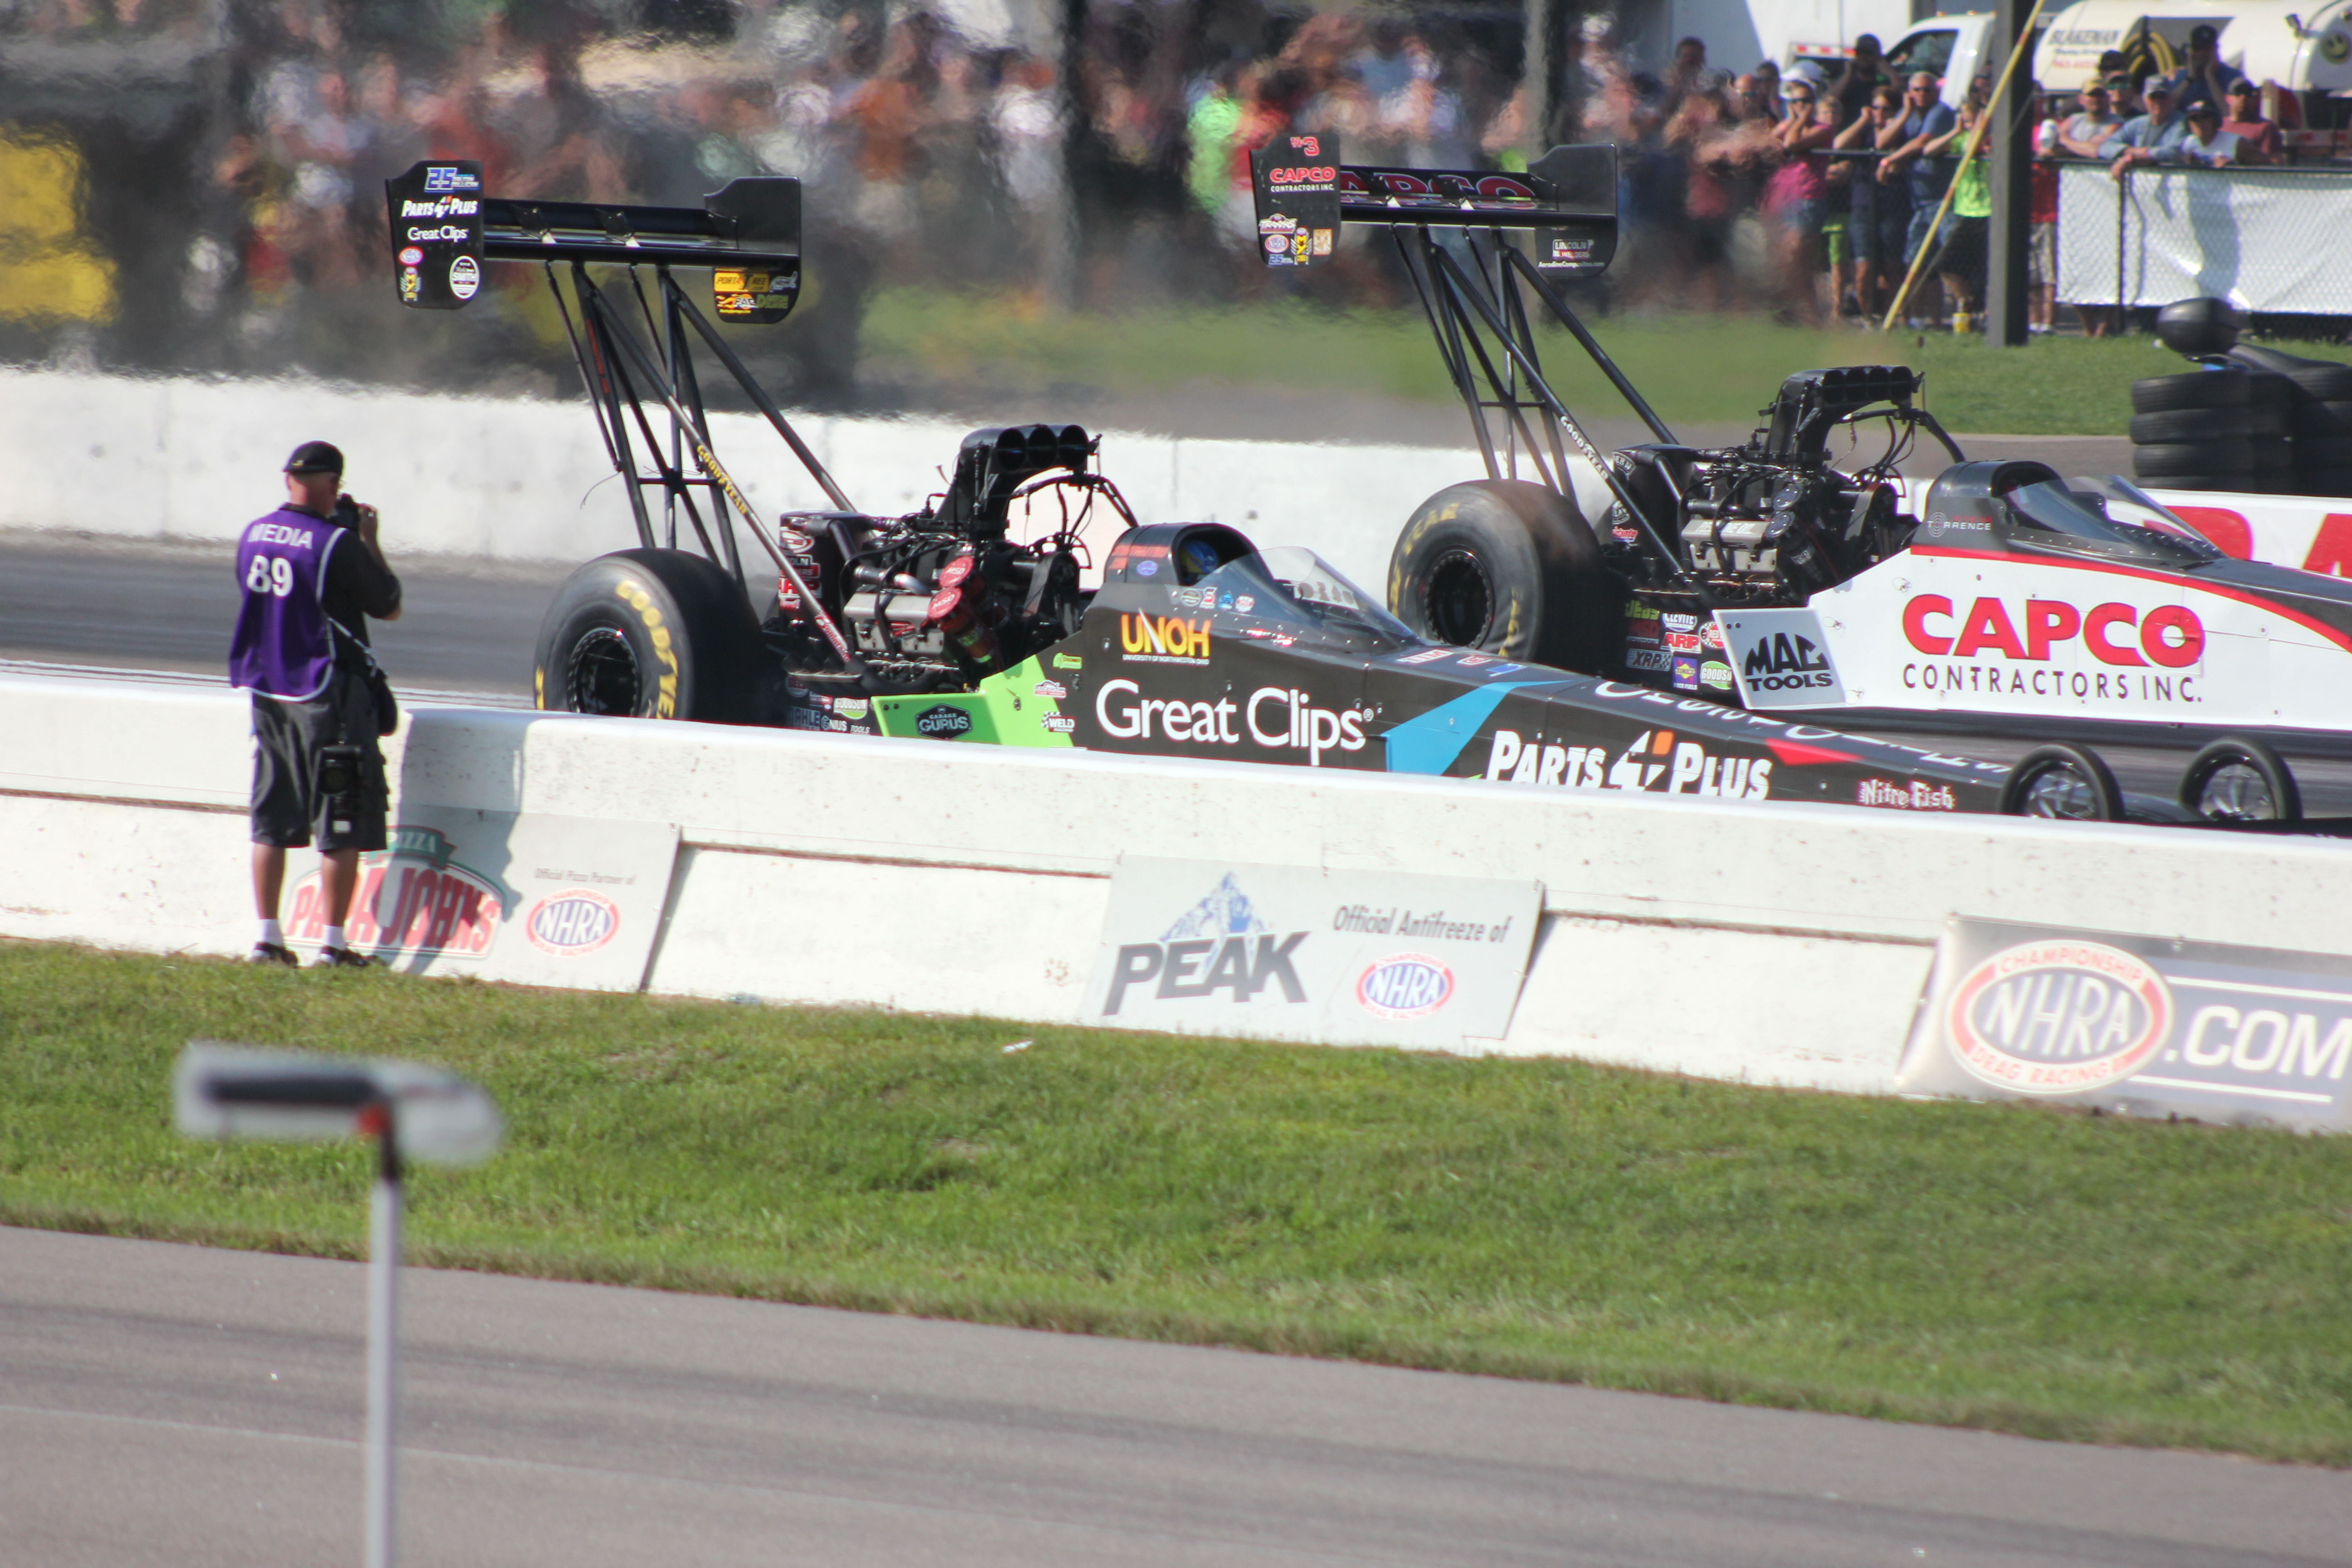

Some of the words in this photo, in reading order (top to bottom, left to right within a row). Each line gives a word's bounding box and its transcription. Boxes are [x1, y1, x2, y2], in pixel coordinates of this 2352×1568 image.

[1303, 137, 1320, 156] 3
[1269, 167, 1336, 183] CAPCO
[1270, 184, 1320, 192] CONTRACTORS
[401, 200, 436, 217] PARTS
[449, 197, 479, 215] PLUS
[407, 226, 440, 240] Great
[440, 225, 469, 243] Clips
[1555, 241, 1587, 250] LINCOLN
[1560, 416, 1608, 480] GOODYEAR
[247, 524, 313, 549] MEDIA
[247, 555, 293, 597] 89
[933, 594, 956, 609] MSD
[1664, 613, 1695, 625] CLEVITE
[1902, 594, 2206, 667] CAPCO
[1121, 609, 1211, 657] UNOH
[1662, 633, 1700, 648] ARP
[1632, 651, 1661, 667] XRP
[1745, 632, 1830, 676] MAC
[1701, 667, 1732, 681] GOODSO
[1746, 673, 1833, 691] TOOLS
[1903, 663, 2128, 699] CONTRACTORS
[2142, 674, 2202, 703] INC.
[919, 716, 969, 732] GURUS
[1049, 718, 1075, 728] WELD
[1096, 679, 1240, 742] Great
[850, 725, 870, 733] TOOLS
[1485, 730, 1607, 789] PARTS
[1668, 742, 1773, 801] PLUS
[1859, 779, 1909, 806] Nitro
[1911, 779, 1955, 809] Fish
[625, 875, 637, 885] of
[288, 867, 387, 944] PAA
[536, 901, 607, 945] NHRA
[1333, 904, 1397, 935] Official
[1395, 909, 1485, 941] Antifreeze
[1488, 915, 1513, 943] of
[1102, 931, 1310, 1016] PEAK
[2000, 946, 2145, 986] CHAMPIONSHIP
[1367, 964, 1442, 1008] NHRA
[1984, 974, 2132, 1057] NHRA
[2164, 1005, 2352, 1079] .COM
[1970, 1046, 2021, 1080] DRAG
[2029, 1063, 2110, 1085] RACING
